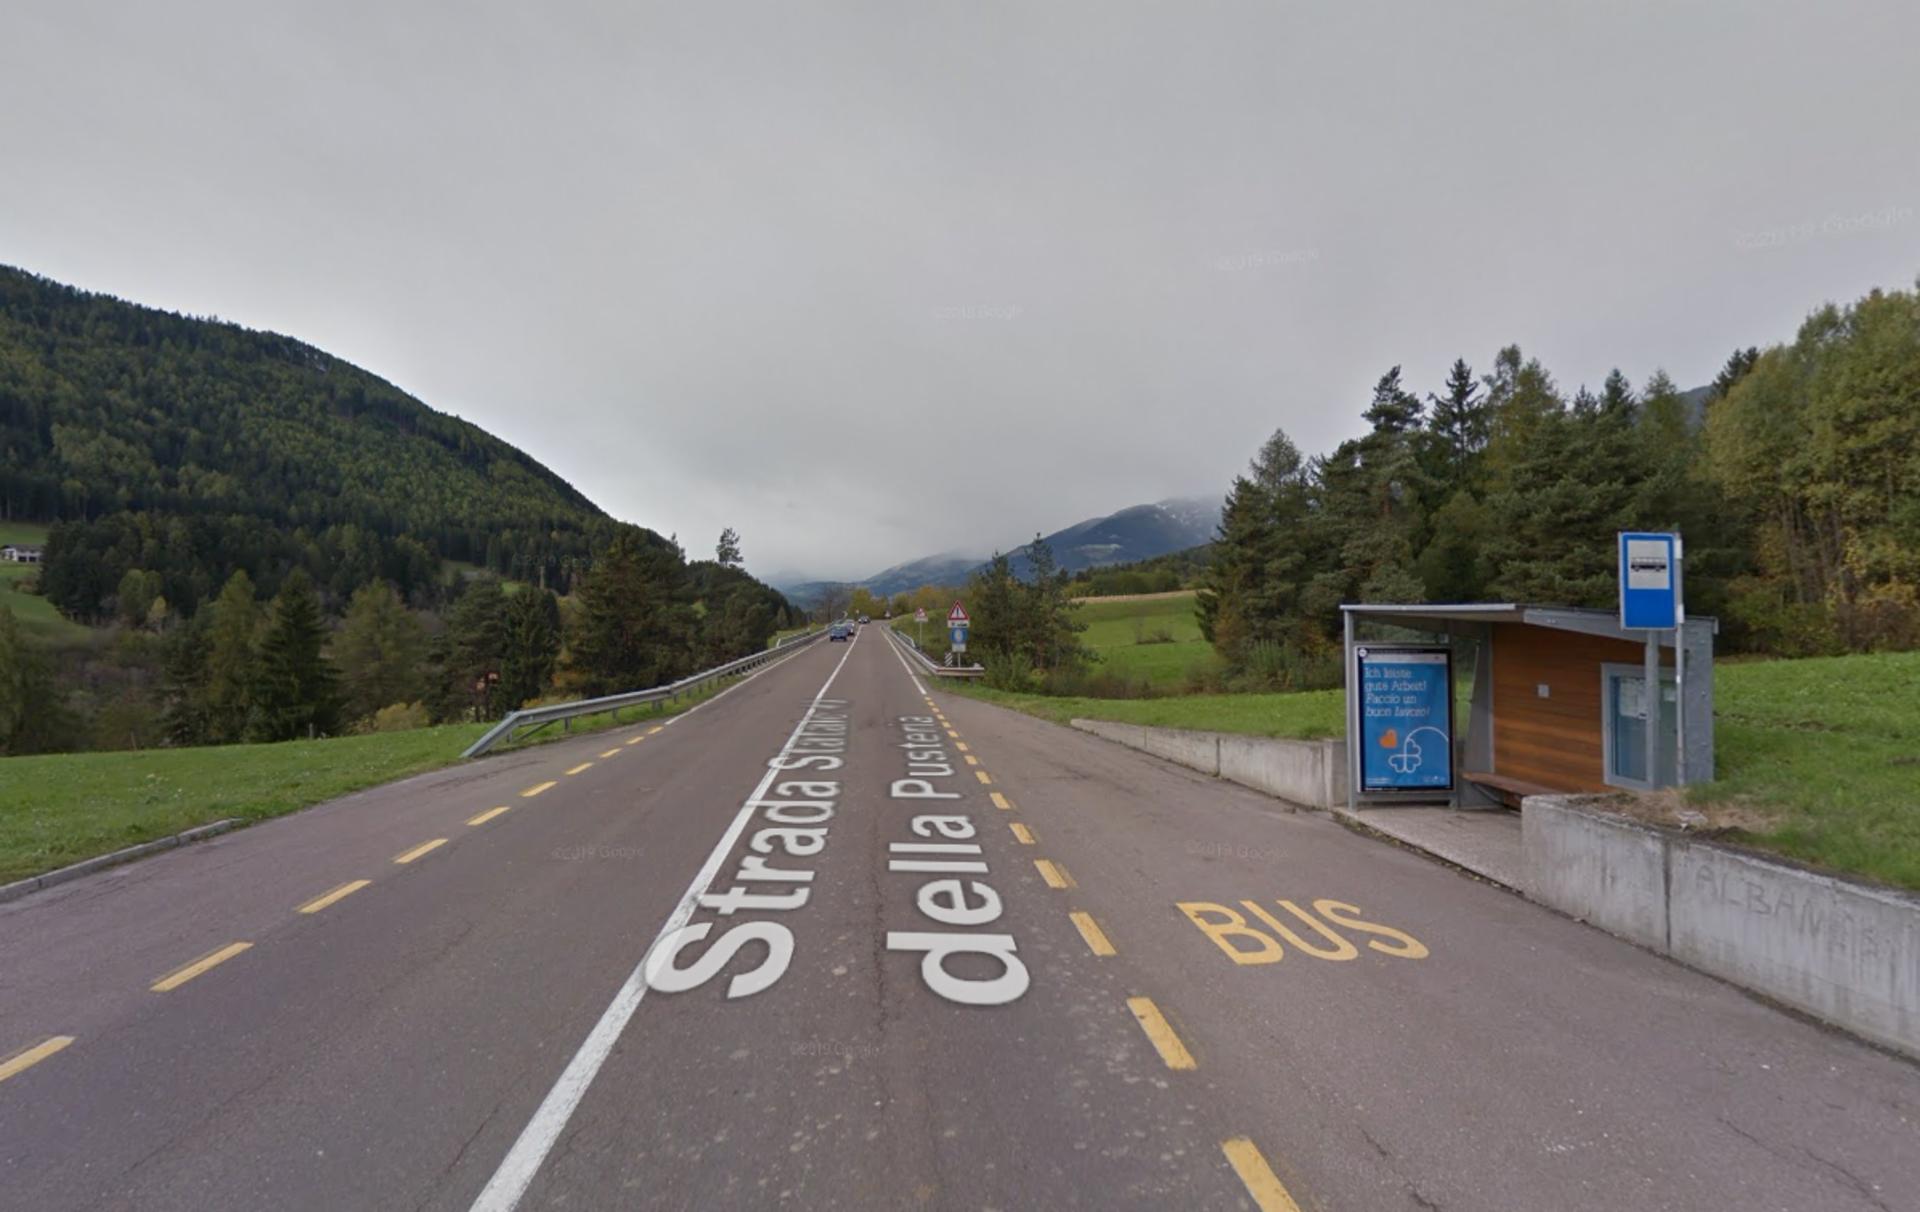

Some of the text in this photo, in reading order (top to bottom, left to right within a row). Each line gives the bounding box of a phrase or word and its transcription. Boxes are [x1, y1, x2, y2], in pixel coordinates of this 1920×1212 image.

[1364, 667, 1381, 679] Ich
[1366, 694, 1417, 704] Faccio un
[1366, 706, 1392, 717] buon
[1175, 899, 1430, 965] BUS
